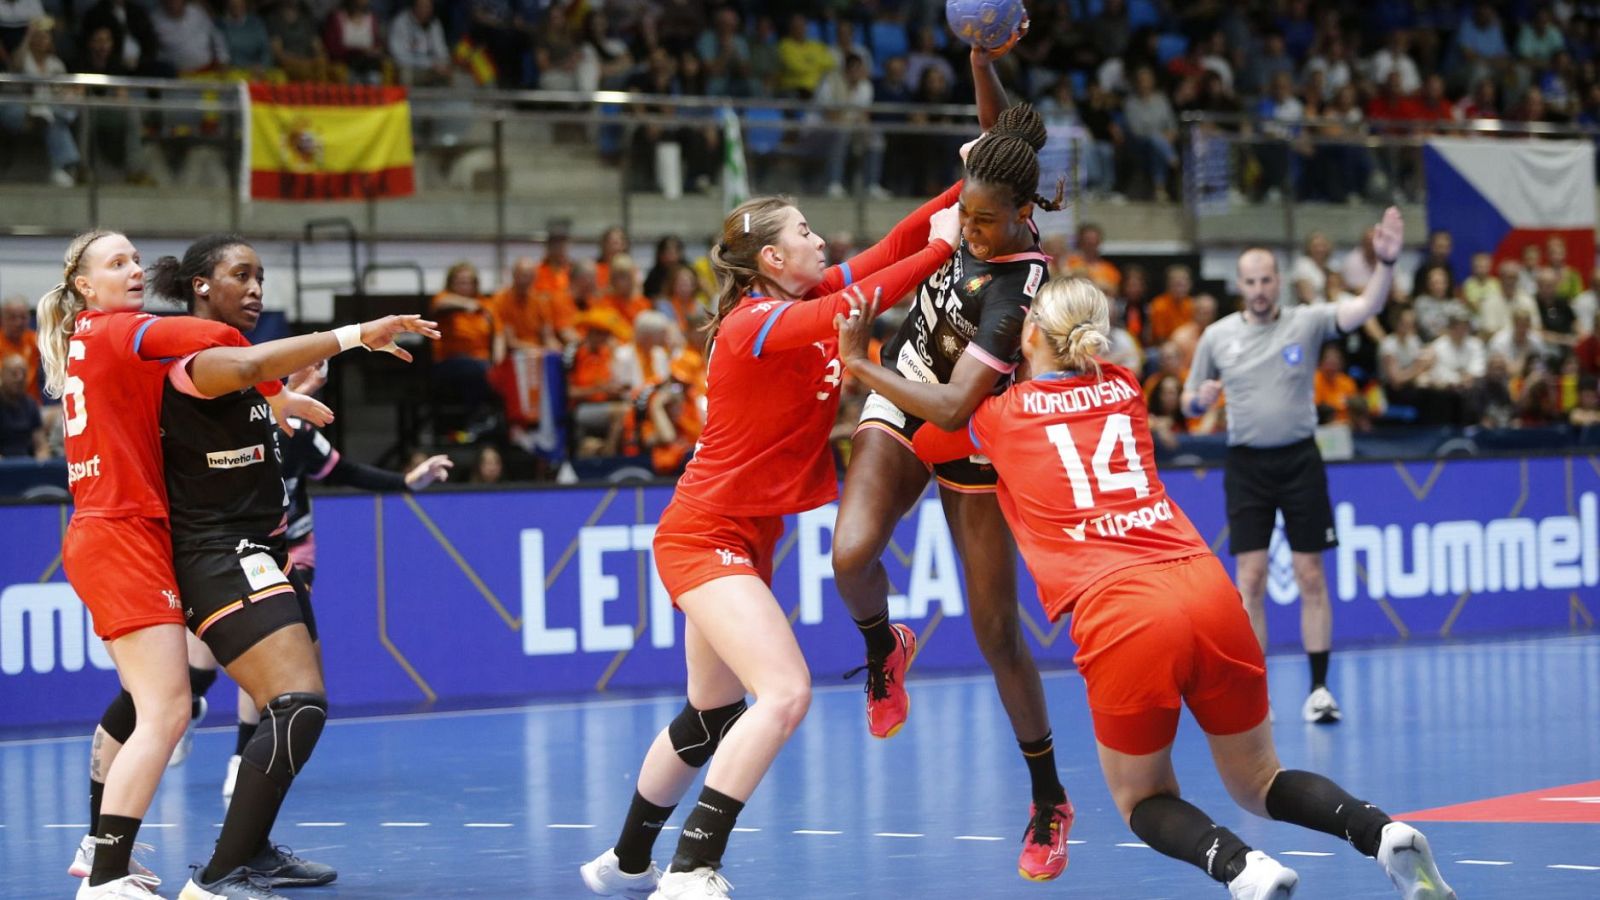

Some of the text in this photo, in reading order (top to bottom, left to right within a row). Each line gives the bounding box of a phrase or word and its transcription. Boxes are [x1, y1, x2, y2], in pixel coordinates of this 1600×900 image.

[900, 349, 932, 384] VARGRO
[209, 453, 251, 466] helvetia
[1045, 413, 1150, 509] 14
[1335, 491, 1599, 601] hummel
